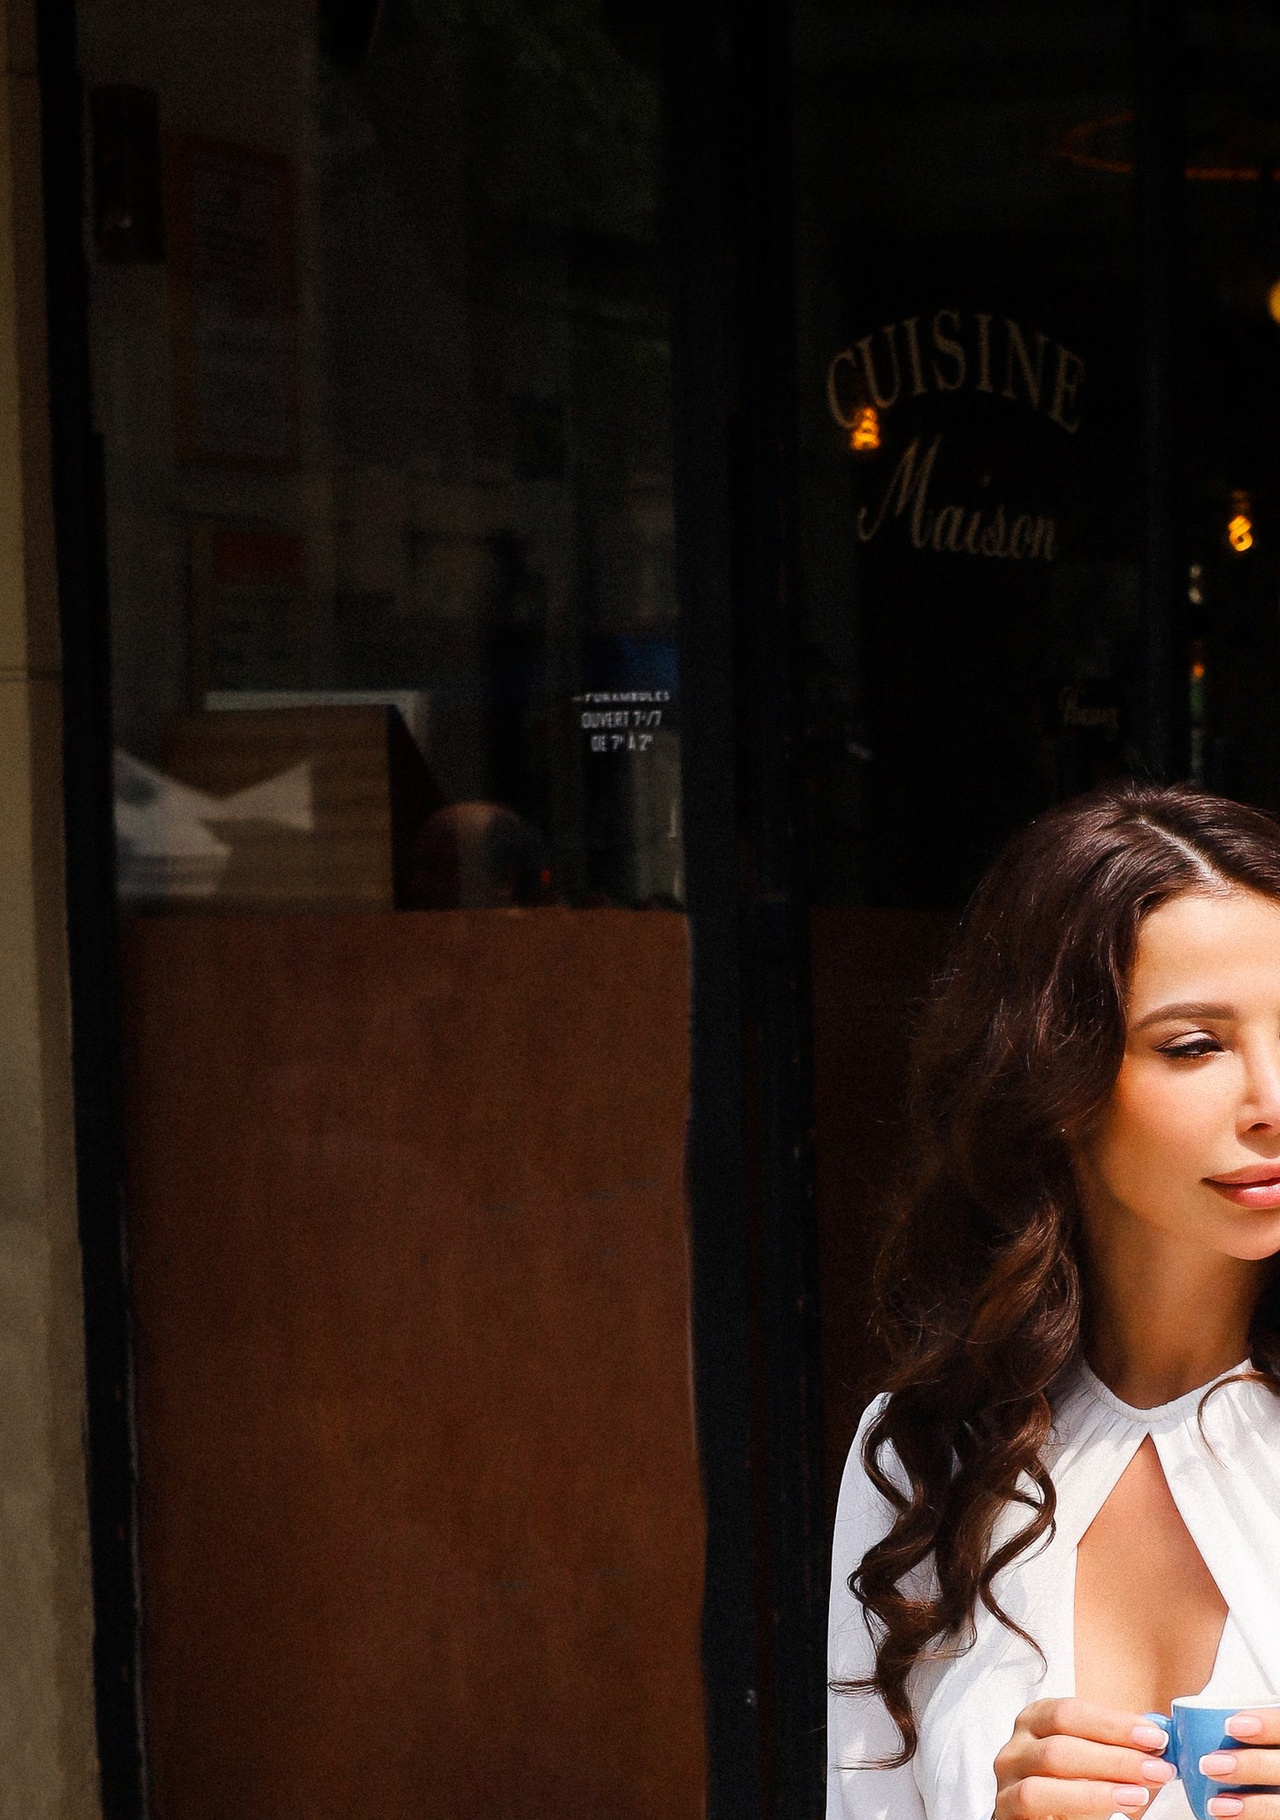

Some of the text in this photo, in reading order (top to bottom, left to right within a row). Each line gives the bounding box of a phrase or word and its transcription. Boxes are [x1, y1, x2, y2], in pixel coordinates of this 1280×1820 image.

[826, 308, 1087, 435] CUISINE
[857, 433, 1058, 562] Maison
[581, 710, 628, 729] OUVERT
[591, 734, 607, 752] DE
